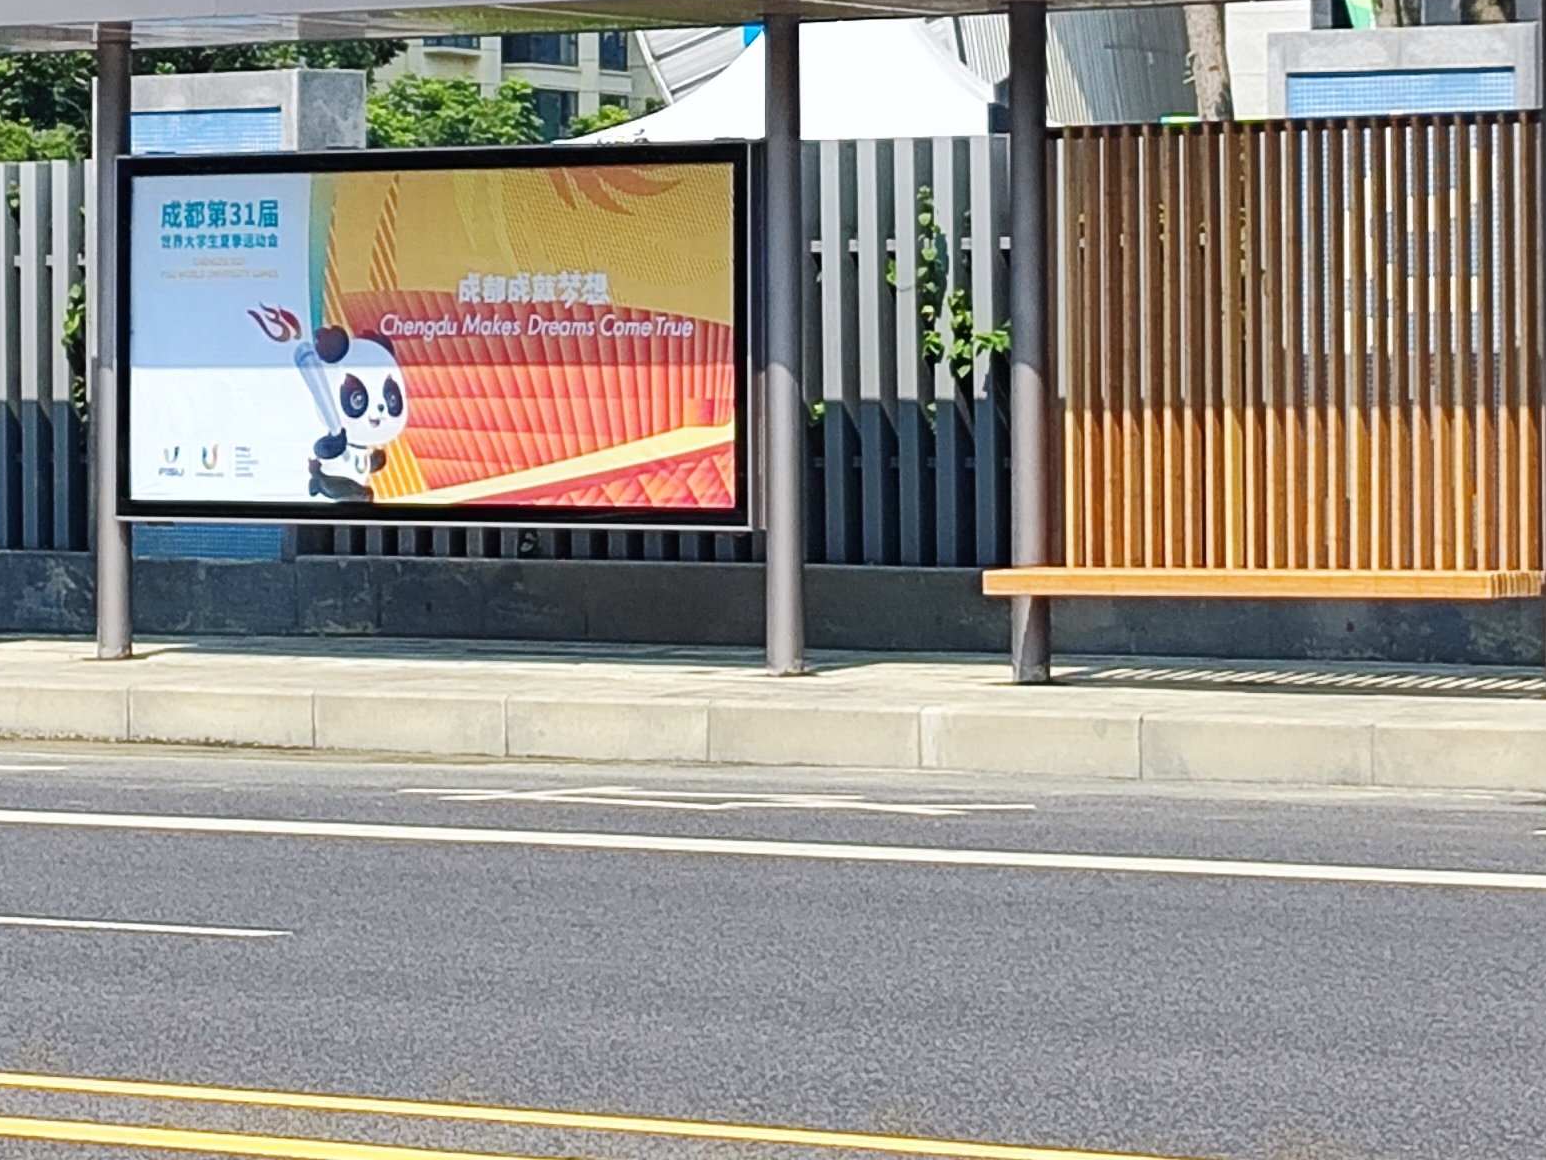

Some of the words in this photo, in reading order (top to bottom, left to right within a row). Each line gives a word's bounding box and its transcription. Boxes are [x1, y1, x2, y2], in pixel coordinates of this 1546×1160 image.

[160, 199, 279, 229] 成都第31届
[160, 233, 279, 249] 世界大学生夏季运动会
[458, 272, 611, 308] 成都成就梦想
[379, 313, 457, 341] Chengdu
[461, 313, 521, 336] Makes
[527, 314, 595, 337] Dreams
[599, 314, 653, 337] Come
[655, 315, 694, 337] True
